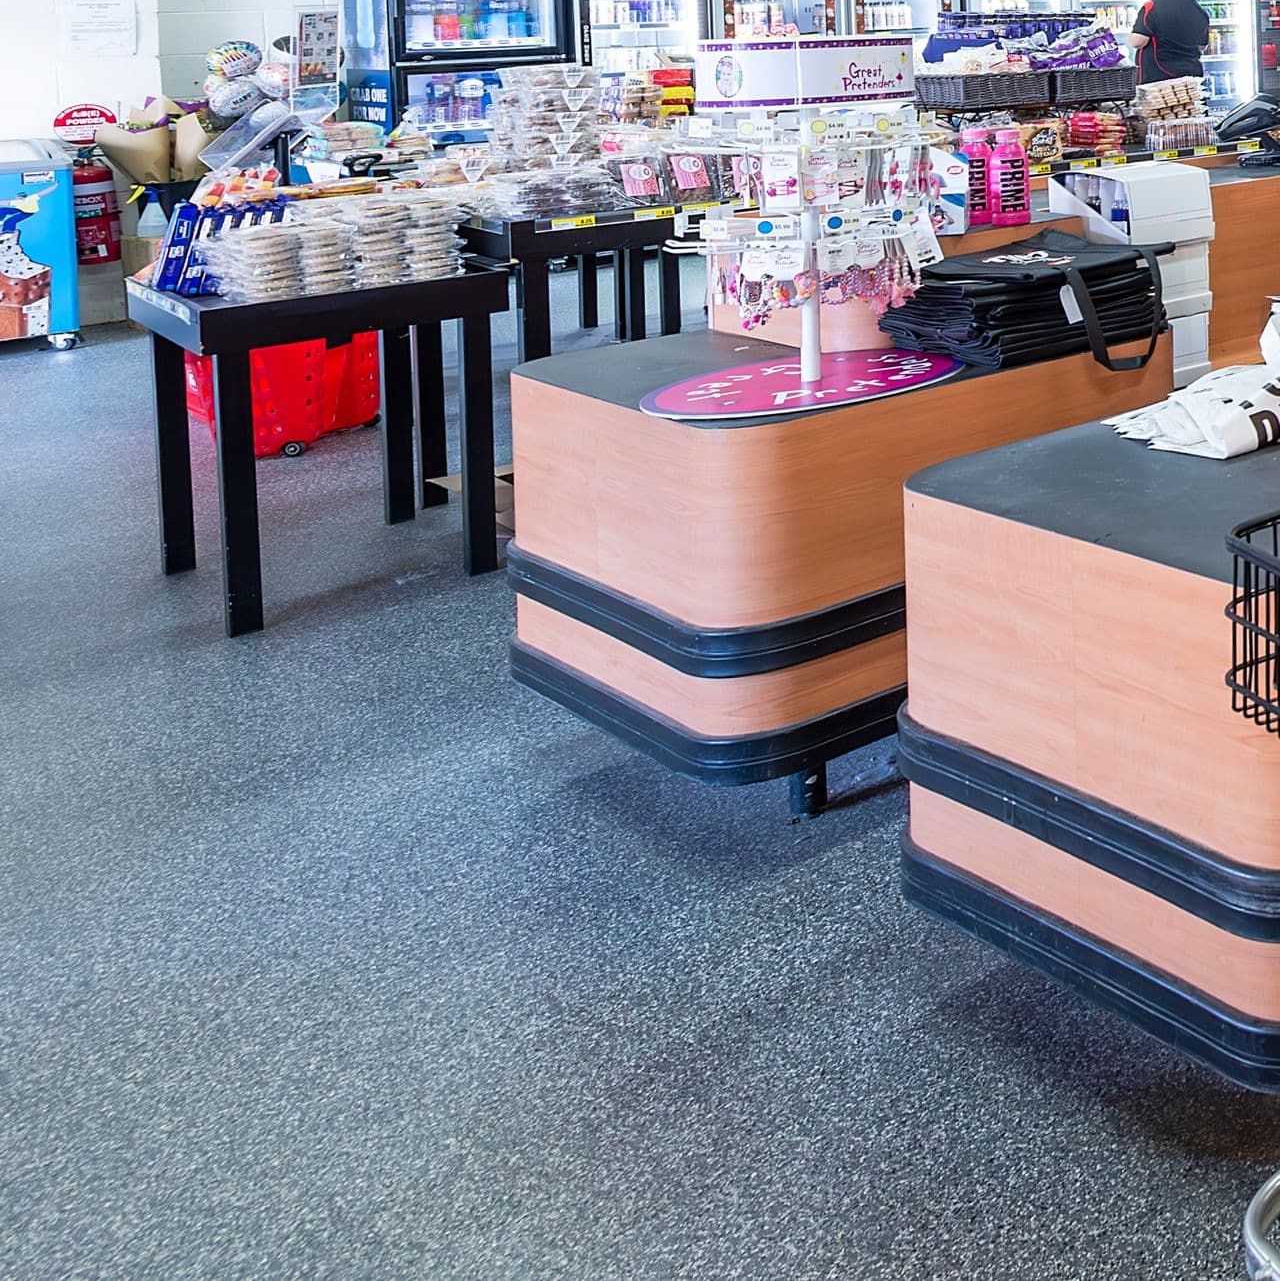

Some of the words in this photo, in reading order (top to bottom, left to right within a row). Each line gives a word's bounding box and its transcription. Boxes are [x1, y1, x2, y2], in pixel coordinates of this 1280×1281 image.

[849, 62, 883, 79] Great
[842, 75, 896, 92] Pretenders
[351, 86, 371, 103] GRAB
[371, 88, 388, 104] ONE
[368, 106, 387, 122] NOW
[967, 158, 987, 213] PRIME
[1000, 158, 1025, 214] PRIME
